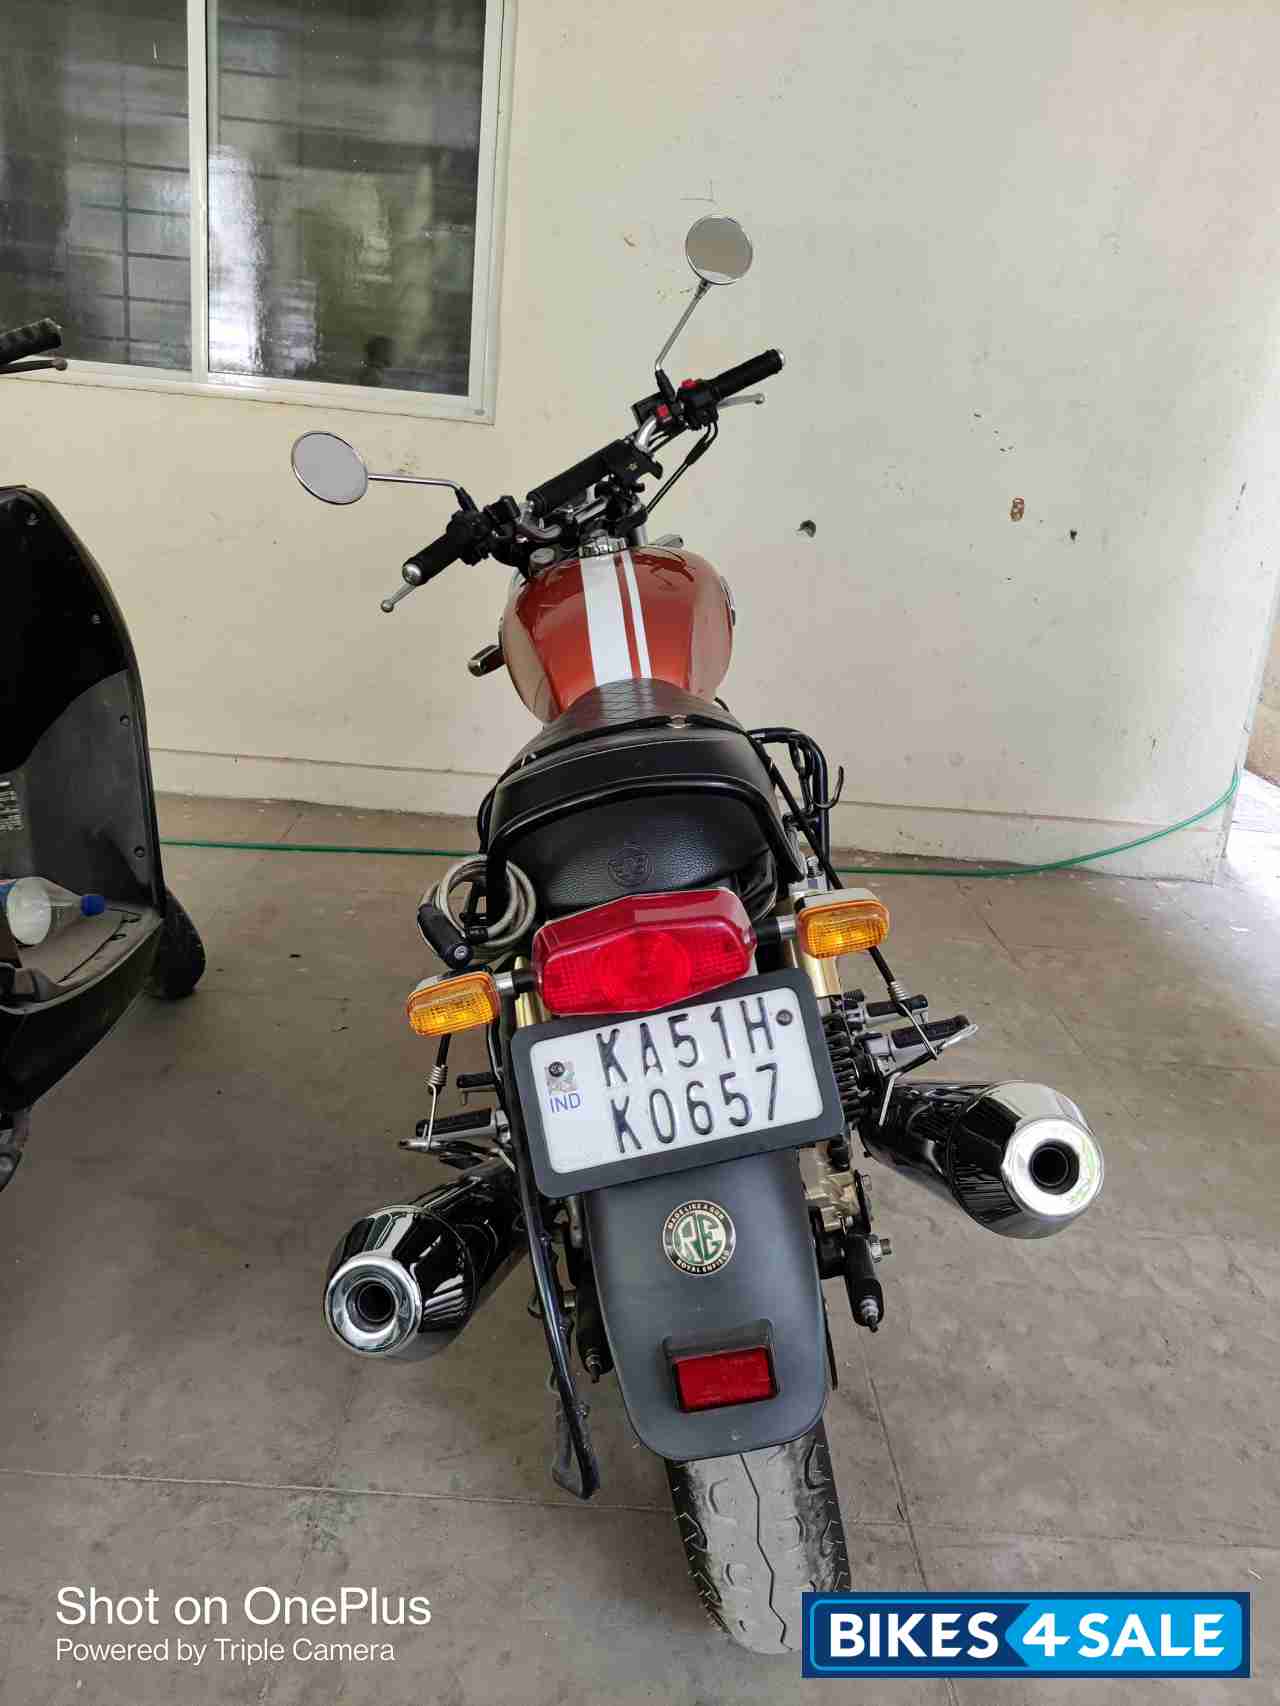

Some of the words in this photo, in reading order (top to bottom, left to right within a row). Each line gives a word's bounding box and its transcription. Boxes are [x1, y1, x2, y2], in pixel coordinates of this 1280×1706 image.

[595, 996, 775, 1088] KA51H
[549, 1093, 582, 1113] IND
[609, 1062, 779, 1154] K0657
